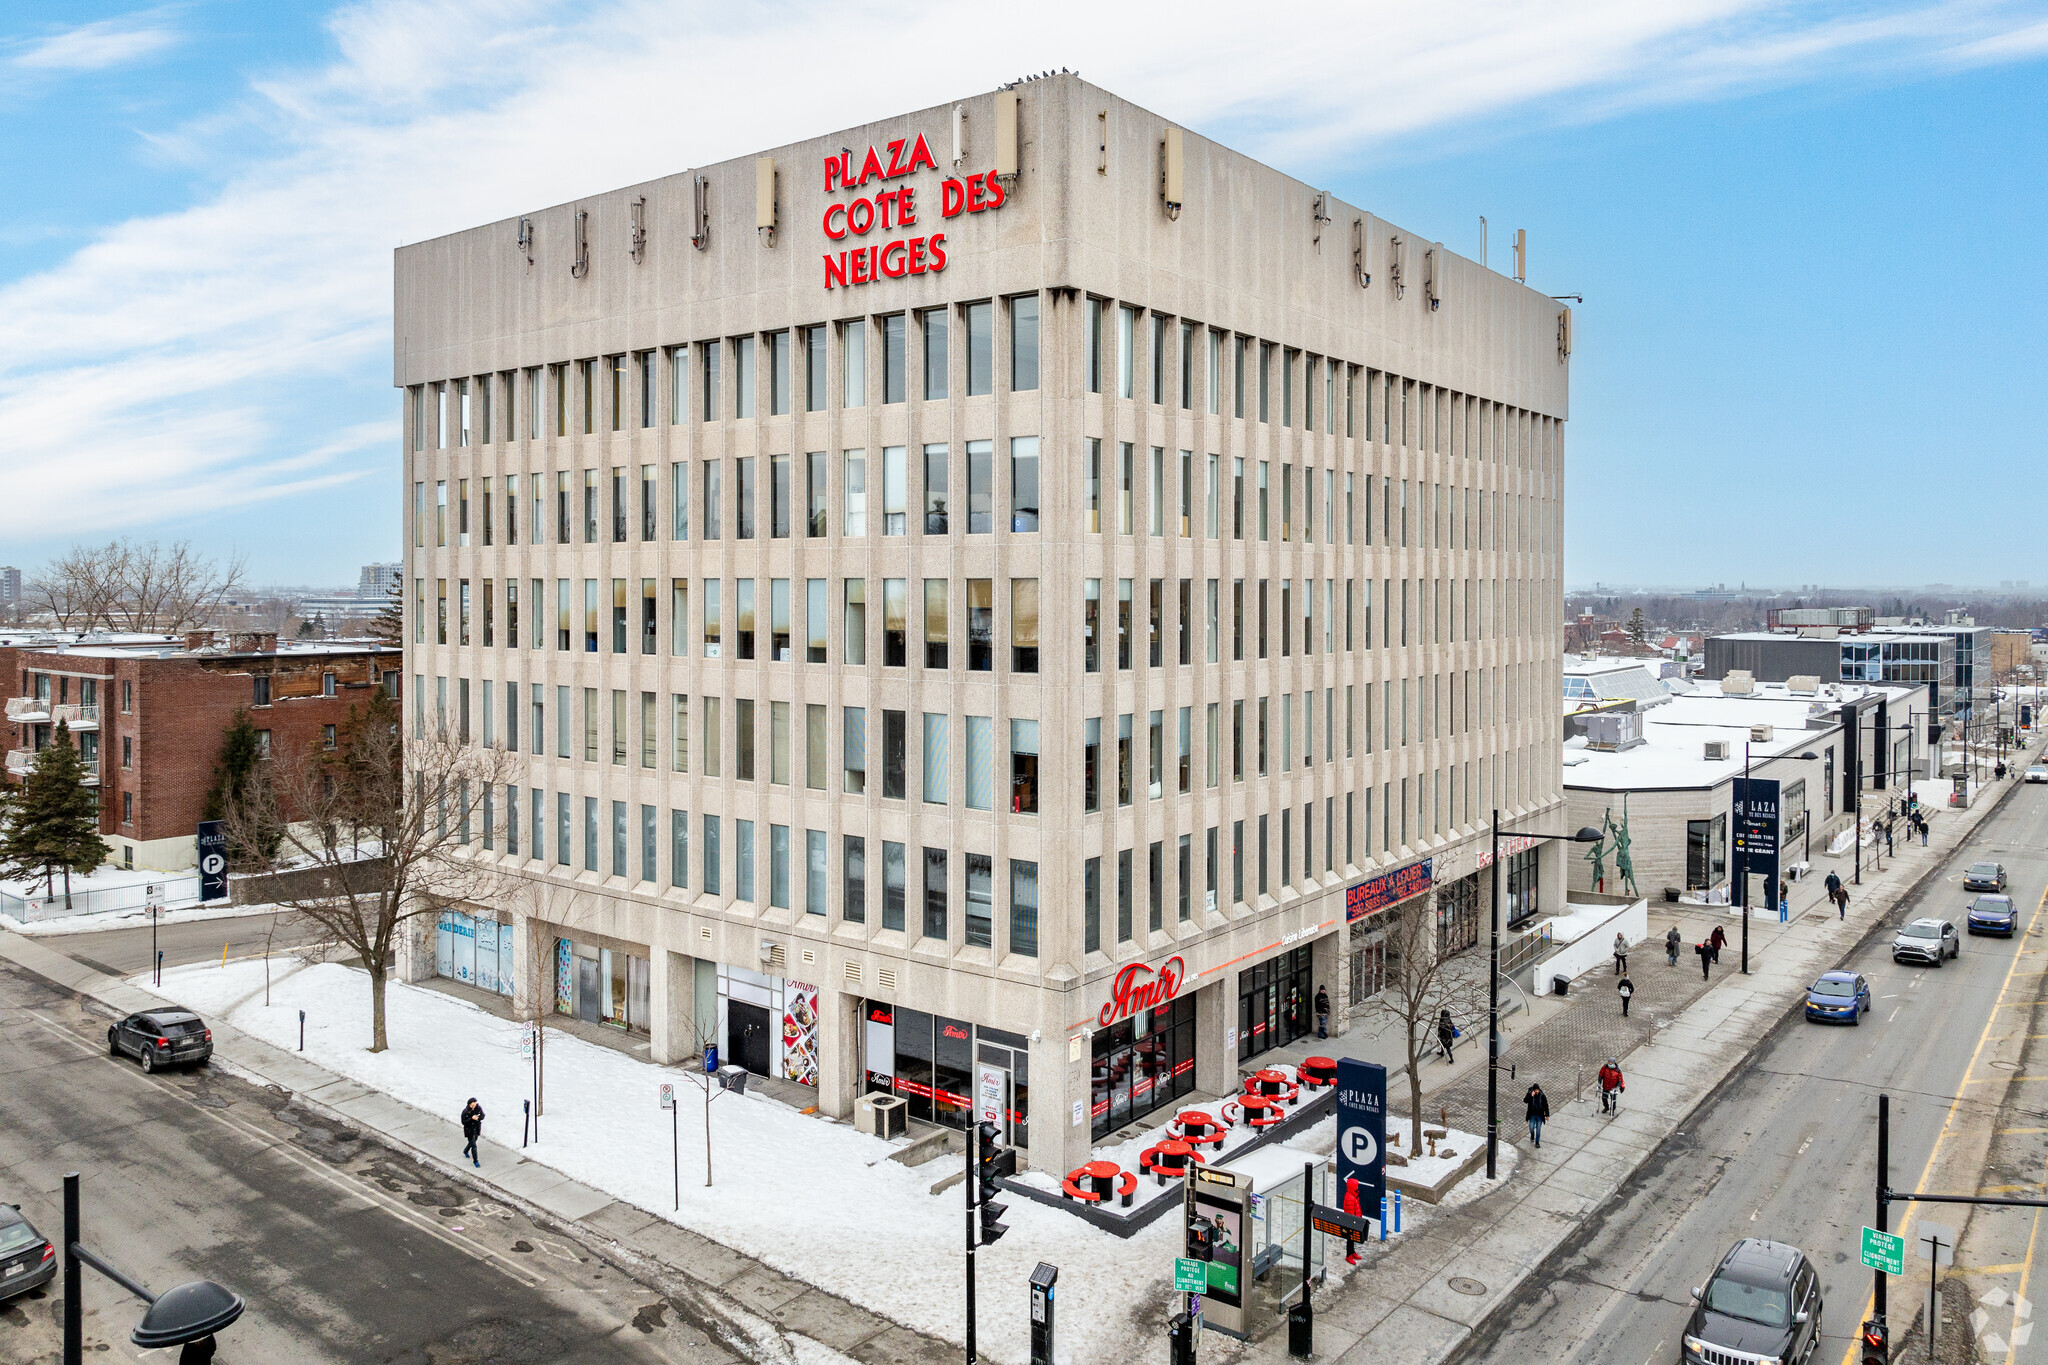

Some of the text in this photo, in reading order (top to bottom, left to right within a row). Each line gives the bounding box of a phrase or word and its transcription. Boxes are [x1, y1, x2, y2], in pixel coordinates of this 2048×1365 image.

[824, 132, 938, 192] PLAZA
[823, 169, 1007, 240] COTE DES
[822, 233, 949, 289] NEIGES
[1751, 801, 1775, 812] LAZA
[208, 857, 219, 872] P
[1347, 876, 1387, 906] BUREAUX
[1396, 864, 1422, 887] LOUER
[1100, 956, 1185, 1027] Amir
[942, 1025, 968, 1040] Amir
[871, 1072, 891, 1087] Amir
[981, 1072, 1000, 1086] Amir
[1349, 1089, 1379, 1107] PLAZA
[1366, 1105, 1380, 1114] NEIGES
[1351, 1132, 1368, 1158] P
[1873, 1232, 1893, 1243] VIRAGE
[1864, 1250, 1899, 1265] CLIGNOTEMENT
[1879, 1247, 1887, 1255] AU
[1183, 1260, 1199, 1268] VIRAGE
[1888, 1264, 1900, 1273] VERT
[1176, 1277, 1204, 1286] CLIGNOTEMENT
